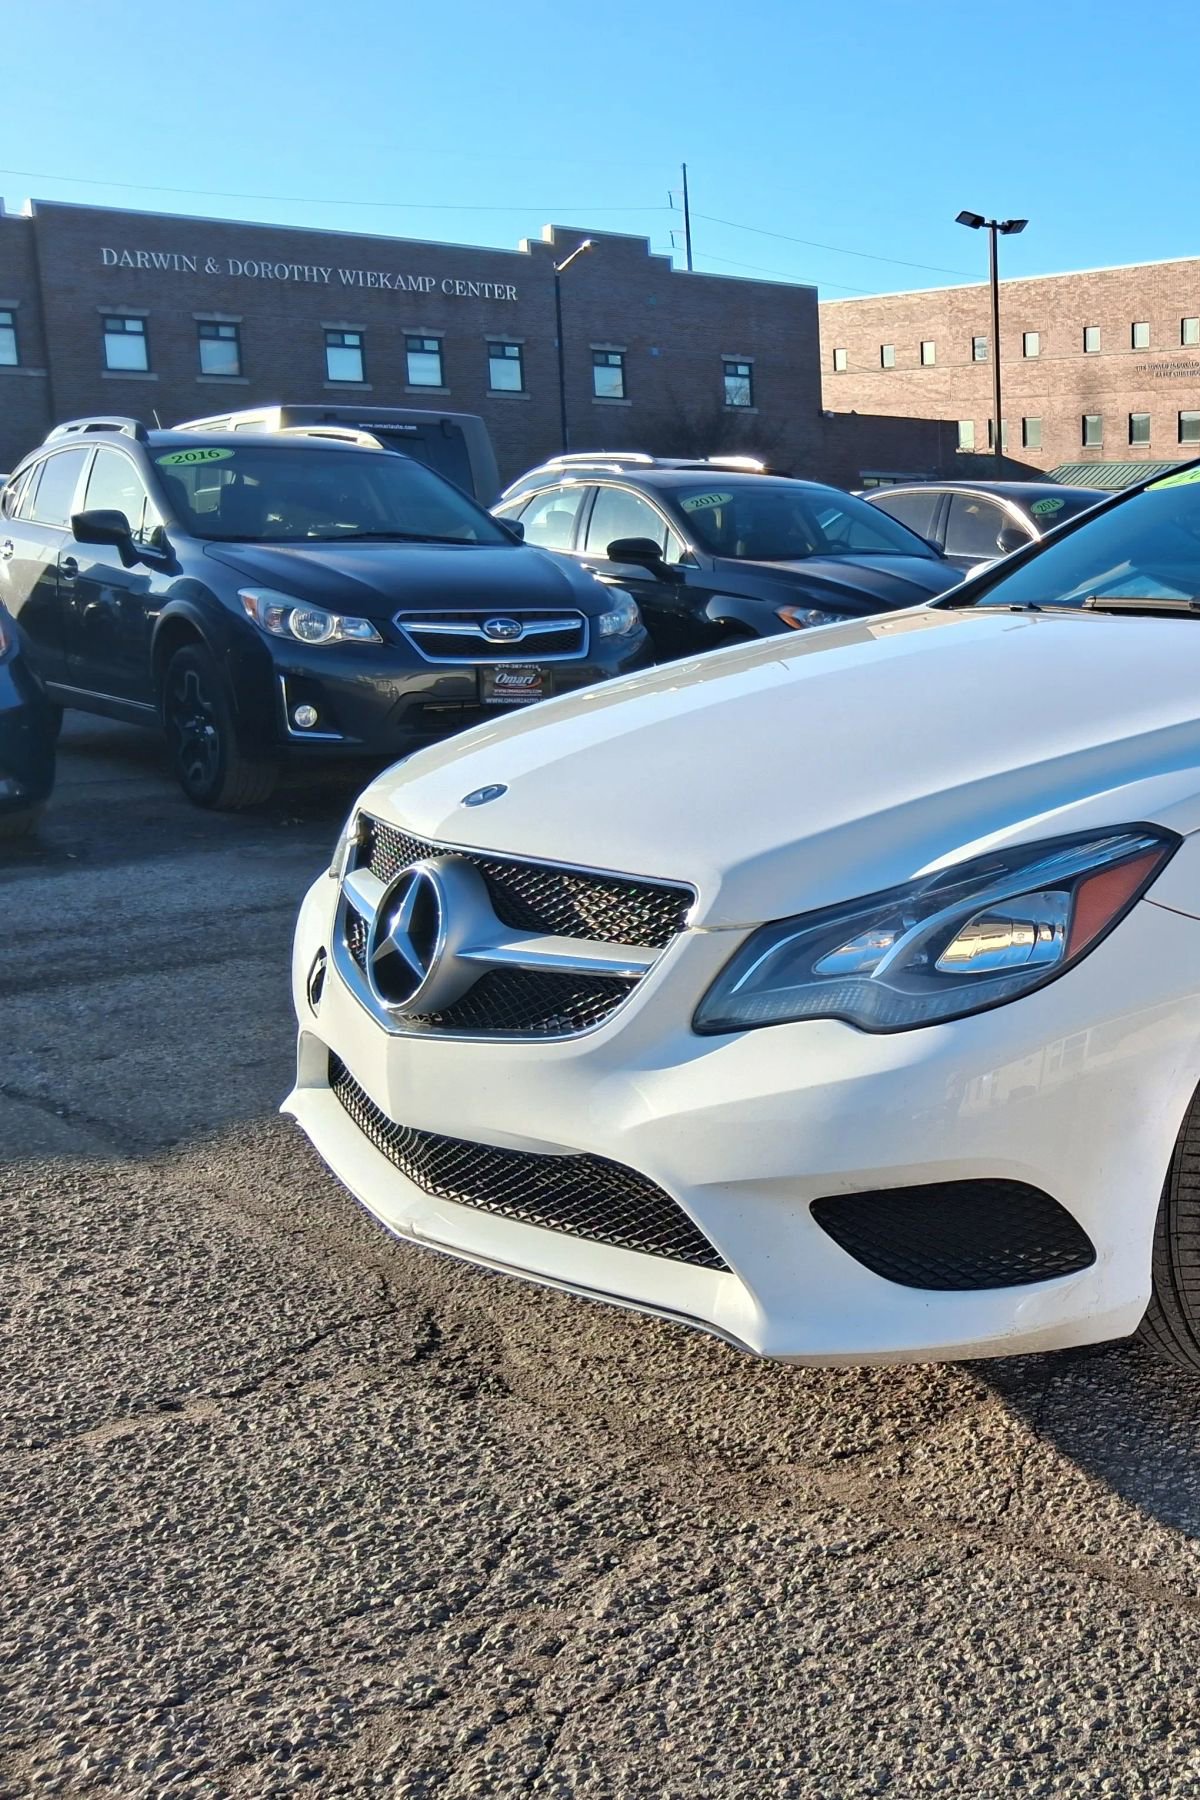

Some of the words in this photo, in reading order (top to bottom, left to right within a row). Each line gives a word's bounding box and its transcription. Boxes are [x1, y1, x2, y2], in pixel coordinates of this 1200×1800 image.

[101, 247, 198, 272] DARWIN
[204, 257, 221, 274] &
[227, 258, 333, 284] DOROTHY
[338, 268, 436, 292] WIEKAMP
[441, 278, 519, 301] CENTER
[171, 449, 221, 464] 2016
[495, 673, 536, 684] Omari
